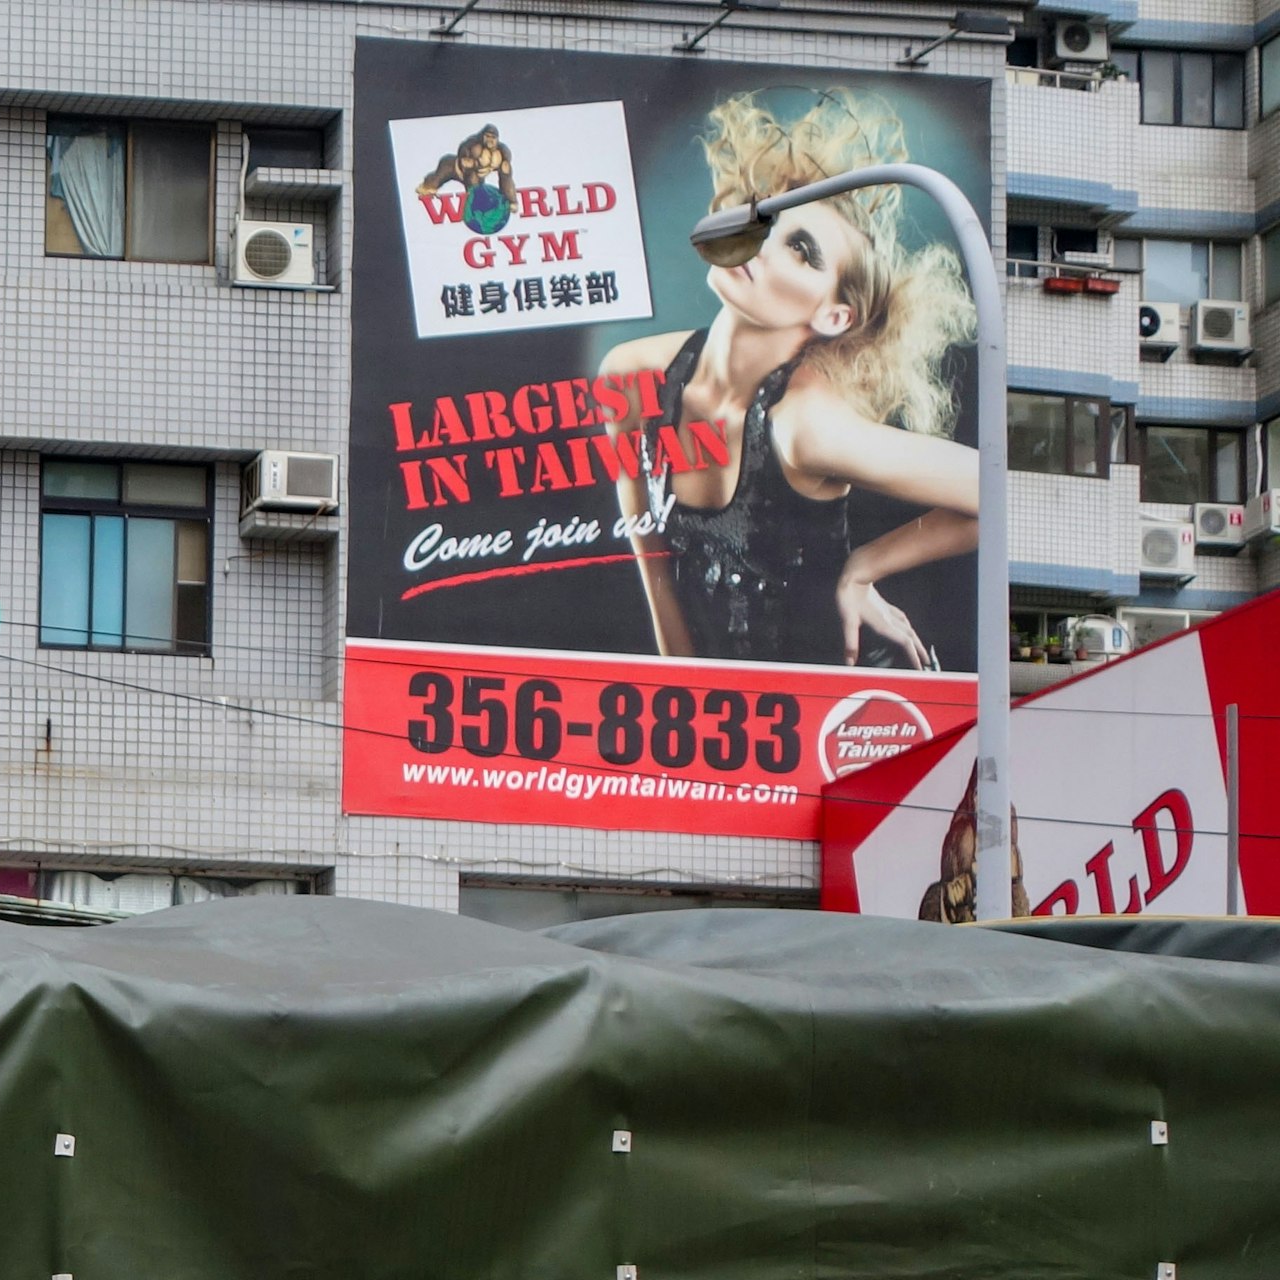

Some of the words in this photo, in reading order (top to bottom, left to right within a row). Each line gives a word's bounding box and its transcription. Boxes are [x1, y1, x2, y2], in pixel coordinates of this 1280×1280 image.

[462, 229, 584, 270] GYM
[440, 269, 620, 319] 健身俱樂部
[388, 368, 668, 453] LARGEST
[399, 453, 471, 511] IN
[485, 419, 731, 498] TAIWAN
[403, 521, 514, 573] Come
[521, 515, 602, 561] join
[407, 671, 802, 775] 356-8833
[837, 723, 899, 740] Largest
[900, 723, 918, 737] In
[402, 759, 799, 806] www.worldgymtaiwan.com
